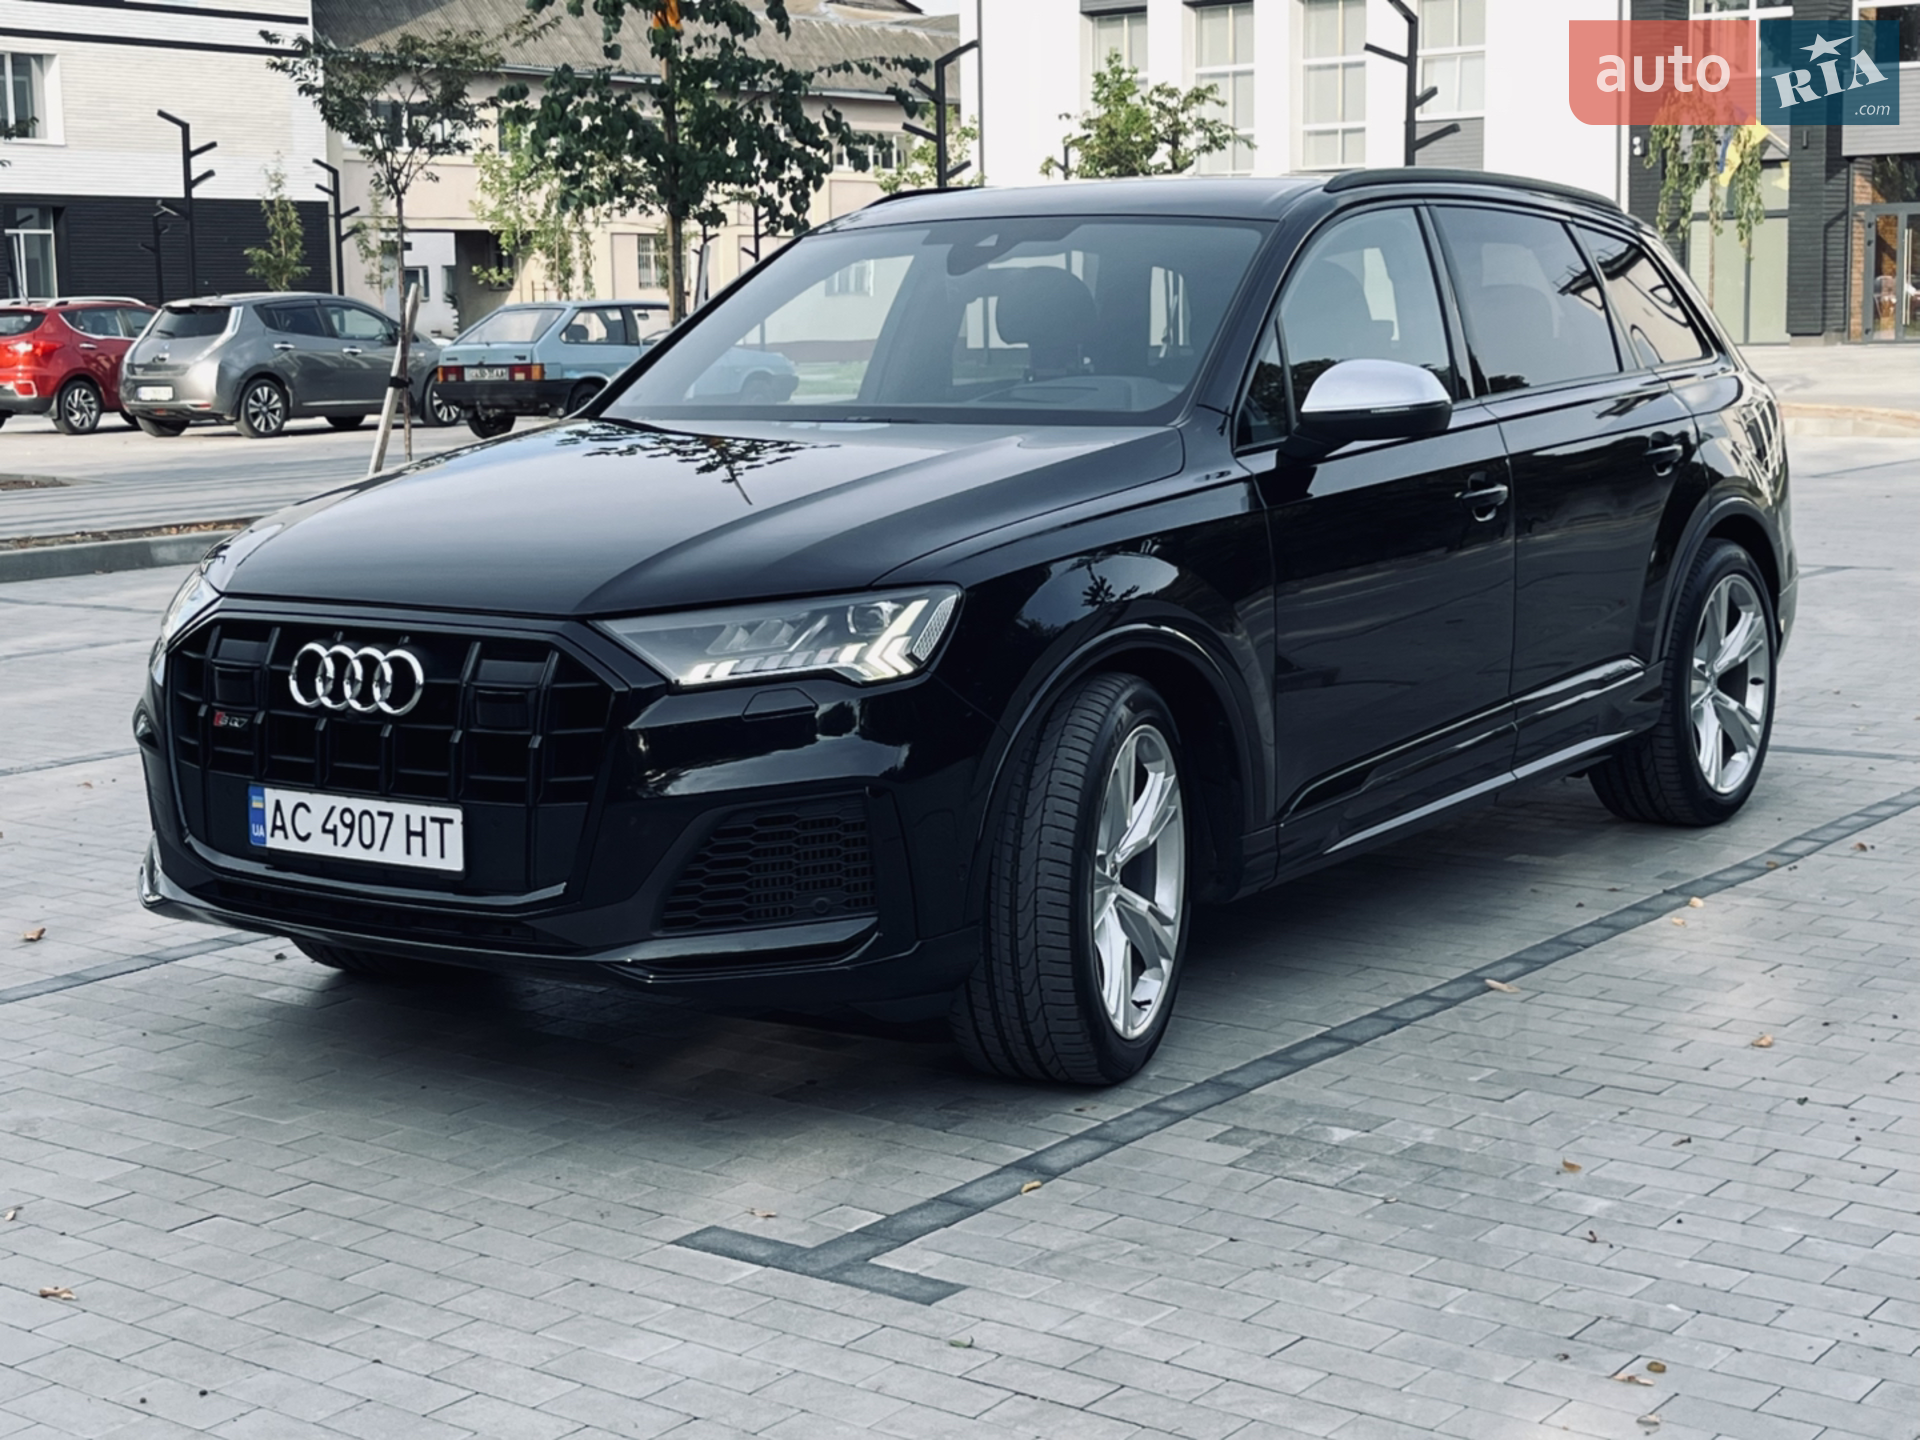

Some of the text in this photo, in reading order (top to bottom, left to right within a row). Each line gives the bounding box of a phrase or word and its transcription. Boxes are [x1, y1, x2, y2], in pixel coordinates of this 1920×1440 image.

[251, 823, 265, 837] UA
[270, 799, 454, 859] AC 4907 HT
